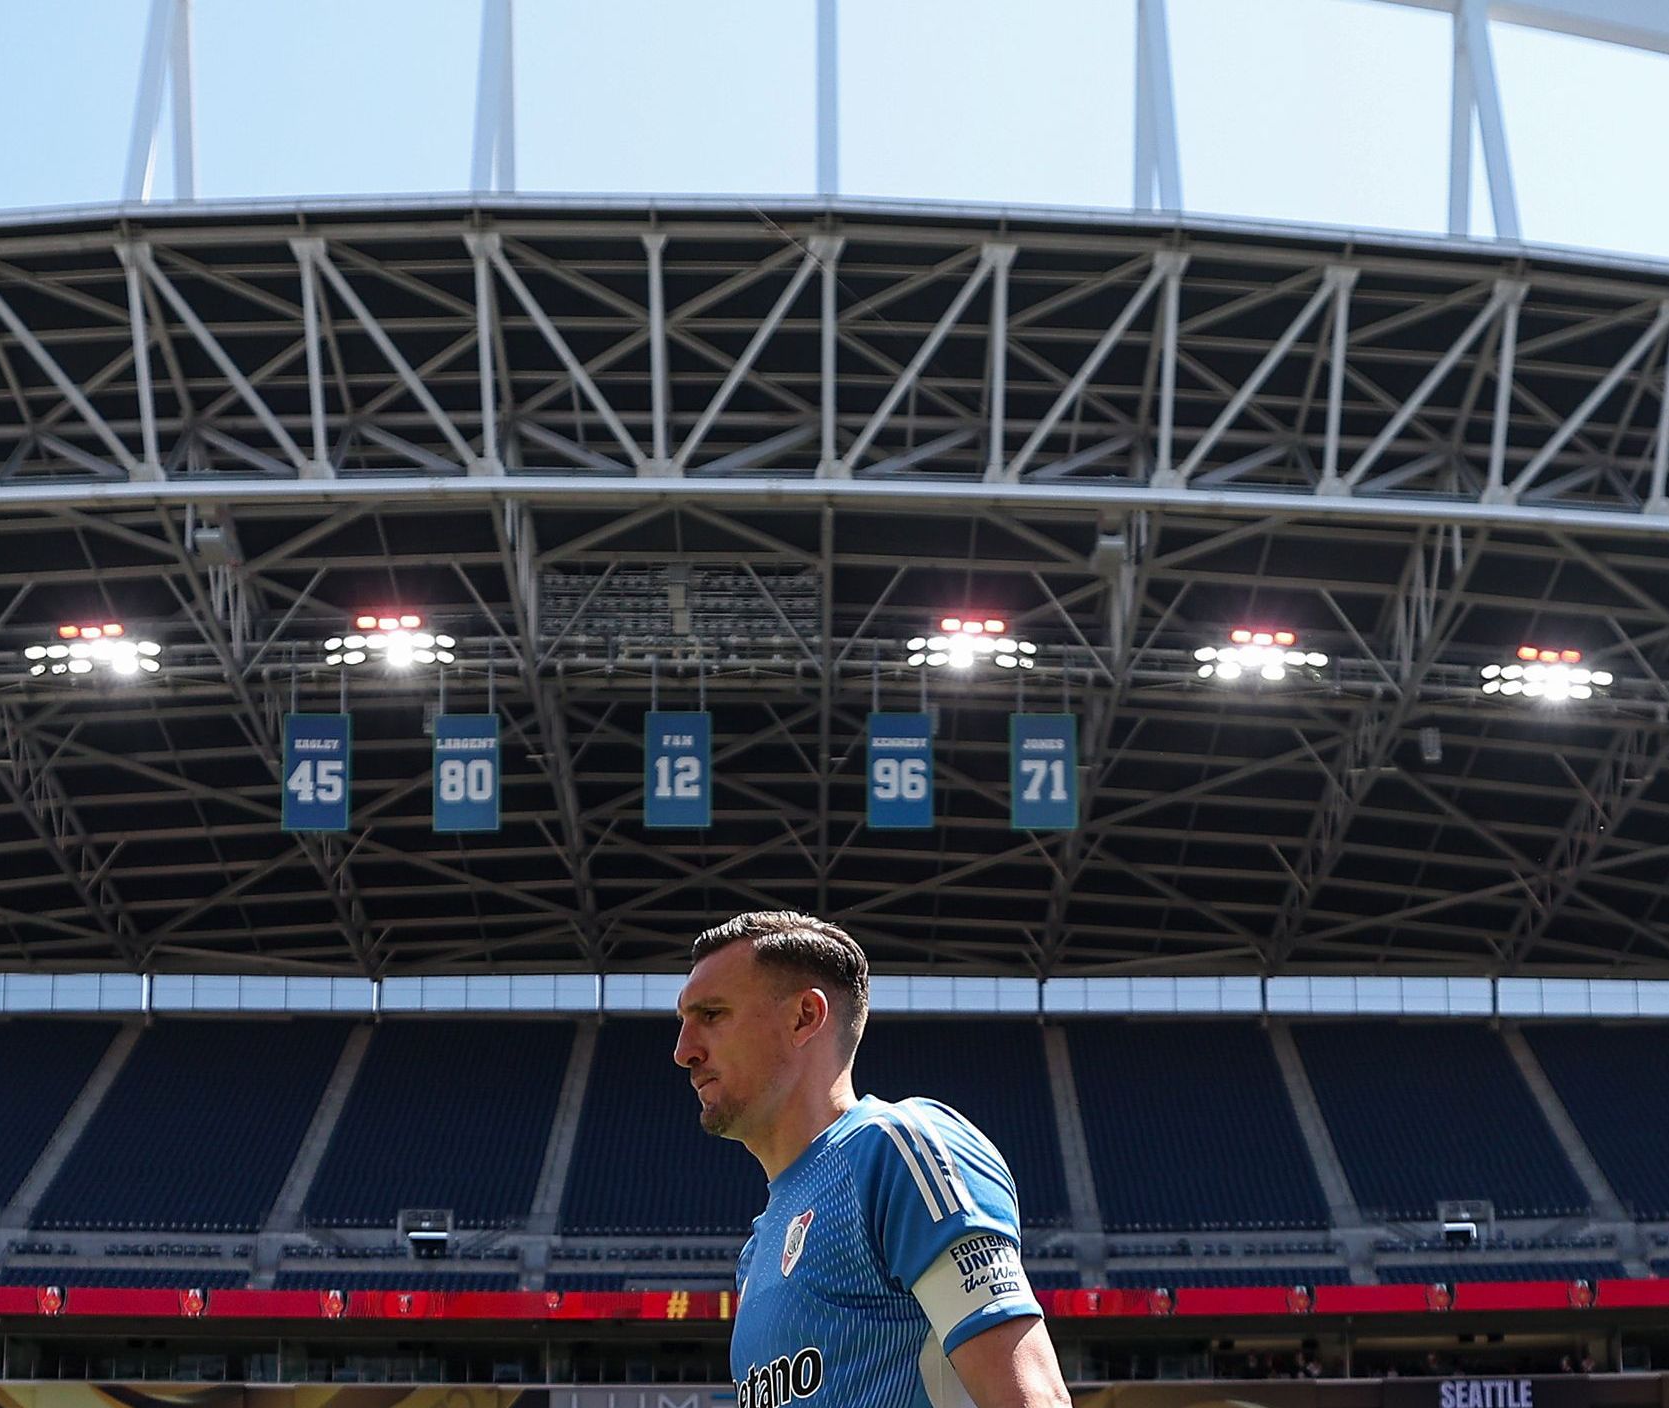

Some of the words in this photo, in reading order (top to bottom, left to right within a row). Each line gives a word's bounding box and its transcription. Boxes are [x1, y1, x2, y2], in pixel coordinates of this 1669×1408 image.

[287, 760, 344, 801] 45
[440, 759, 493, 801] 80
[655, 756, 701, 797] 12
[873, 758, 927, 799] 96
[1020, 759, 1068, 800] 71
[961, 1275, 990, 1293] the
[993, 1283, 1018, 1294] FIFA
[1440, 1380, 1533, 1408] SEATTLE
